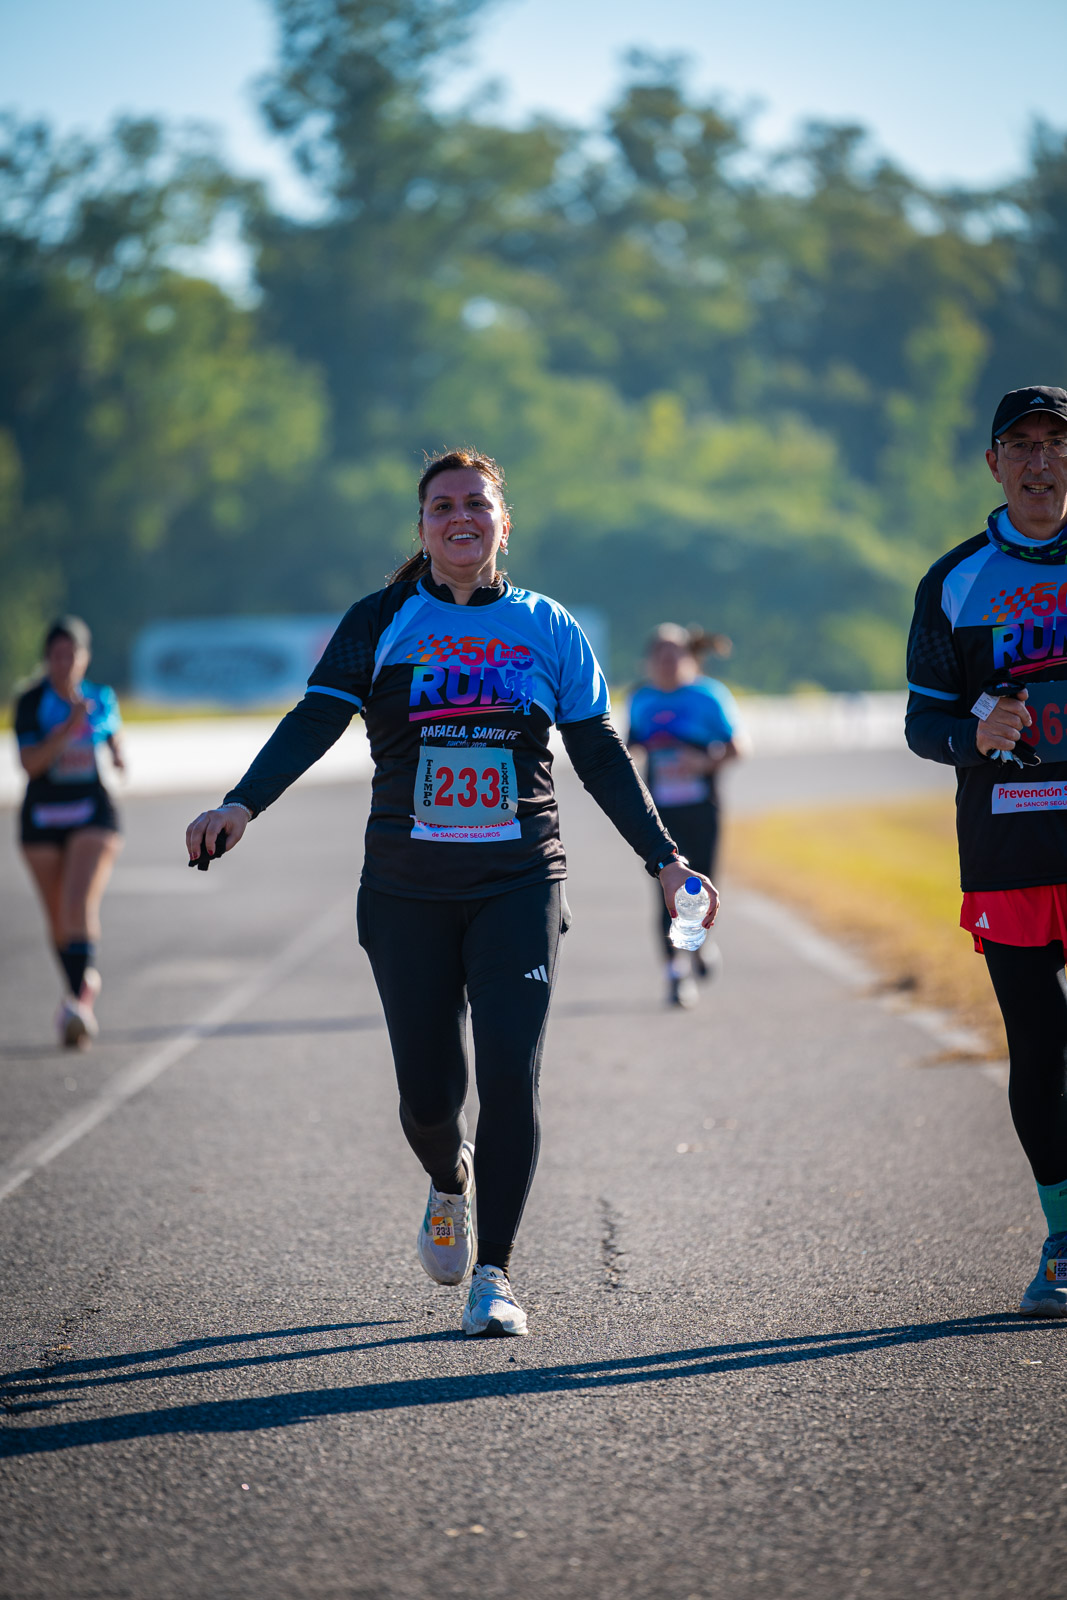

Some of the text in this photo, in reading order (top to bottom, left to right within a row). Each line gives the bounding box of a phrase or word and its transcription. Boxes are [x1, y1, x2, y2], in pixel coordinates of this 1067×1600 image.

[408, 665, 517, 707] RUN
[420, 724, 522, 740] RAFAELA, SANTA FE
[1020, 701, 1067, 748] 36
[422, 759, 434, 807] TIEMPO
[434, 766, 501, 808] 233
[500, 762, 509, 810] EXACTO
[998, 786, 1062, 799] Prevención
[470, 831, 501, 839] SEGUROS
[435, 1226, 451, 1236] 233
